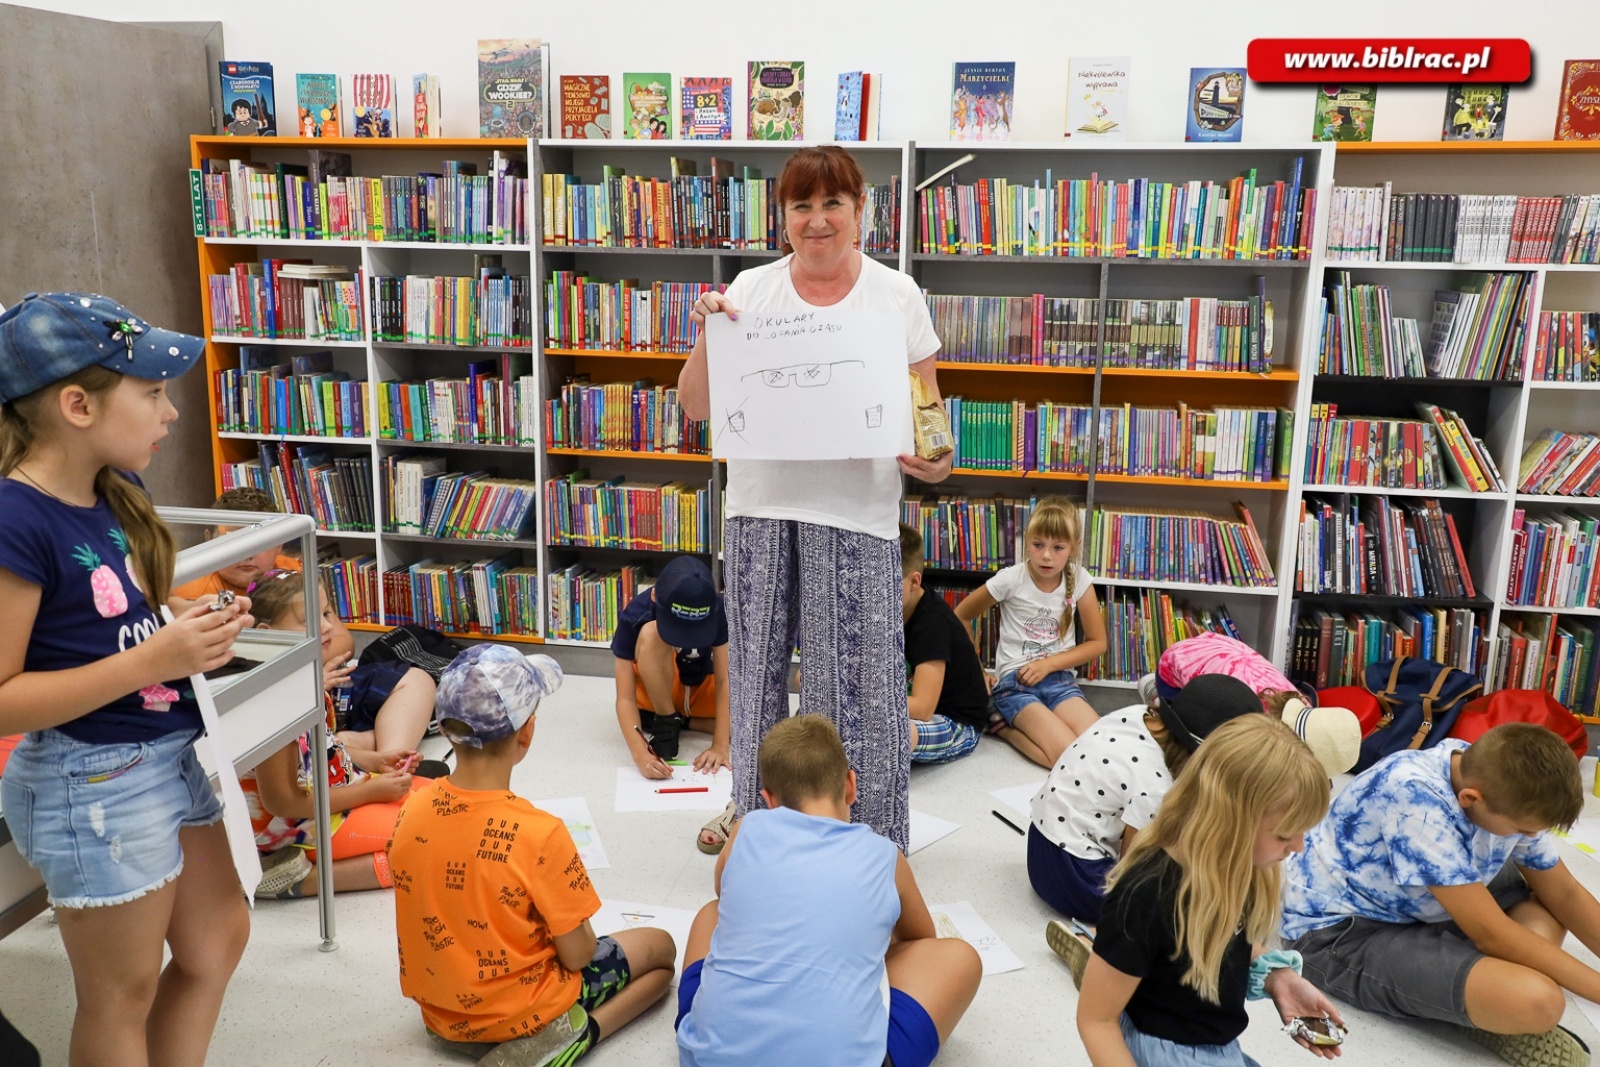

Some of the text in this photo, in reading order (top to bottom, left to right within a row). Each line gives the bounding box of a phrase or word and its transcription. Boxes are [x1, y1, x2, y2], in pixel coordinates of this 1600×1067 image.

[959, 73, 1010, 82] MARZYCIELKI
[1084, 80, 1119, 90] wyprawa
[488, 92, 532, 100] WOOKIEE?
[696, 94, 716, 107] 8+2
[192, 174, 203, 231] 8-11 LAT
[754, 312, 814, 329] OKULARY
[1509, 544, 1519, 596] NASTOLATKI
[672, 602, 710, 616] REBEL
[432, 799, 450, 808] THAN
[436, 804, 470, 816] PLASTIC
[487, 818, 520, 832] OUR
[483, 828, 516, 842] OCEANS
[480, 839, 512, 852] OUR
[476, 850, 509, 864] FUTURE
[446, 868, 466, 876] OCEANS
[445, 882, 464, 891] FUTURE
[478, 958, 509, 968] OCEANS
